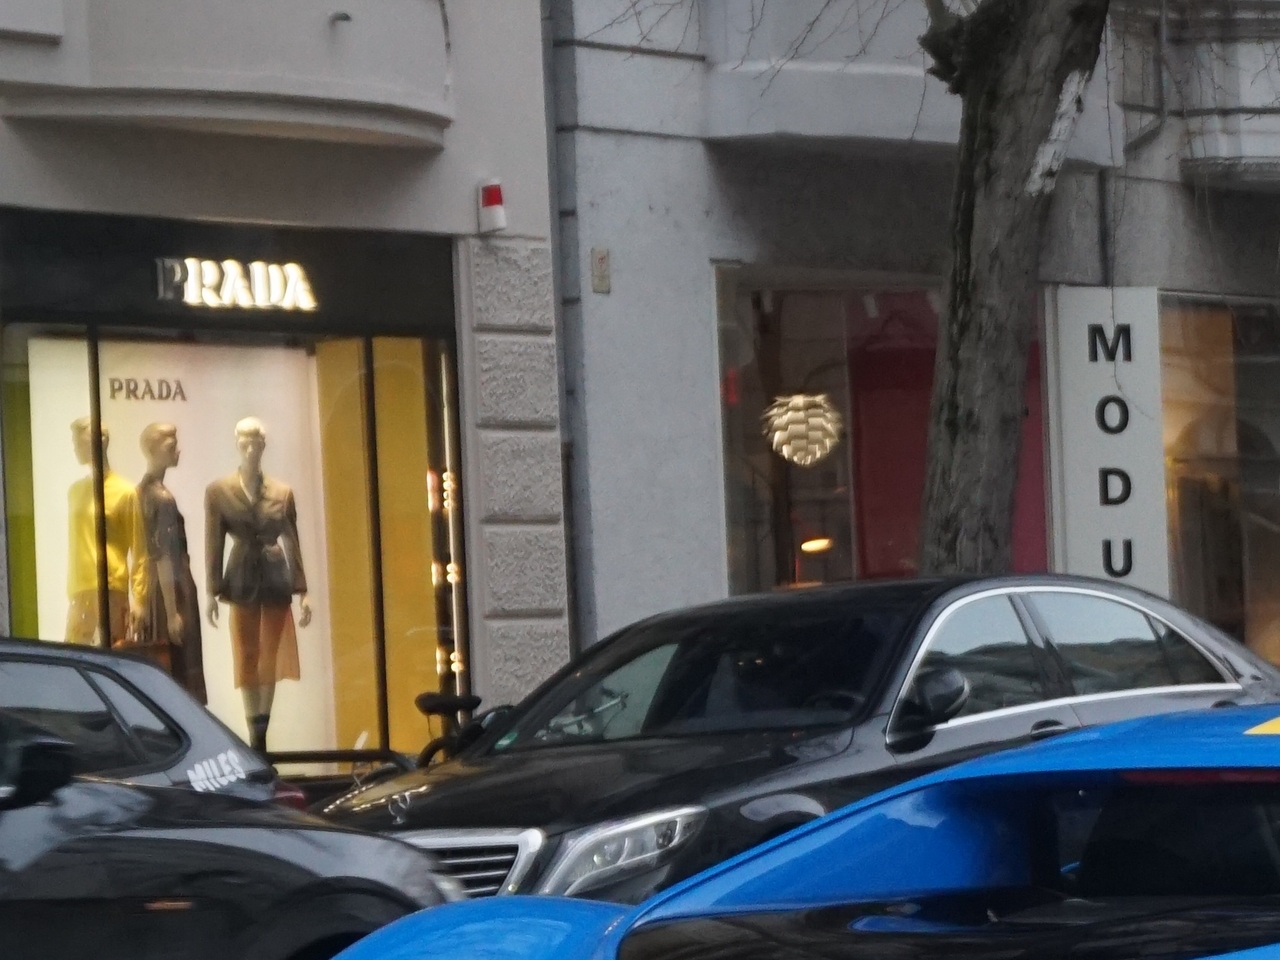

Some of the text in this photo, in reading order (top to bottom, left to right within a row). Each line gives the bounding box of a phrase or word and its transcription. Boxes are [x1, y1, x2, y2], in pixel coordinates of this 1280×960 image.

[155, 257, 318, 311] PRADA
[108, 377, 187, 401] PRADA
[187, 750, 246, 792] MILES
